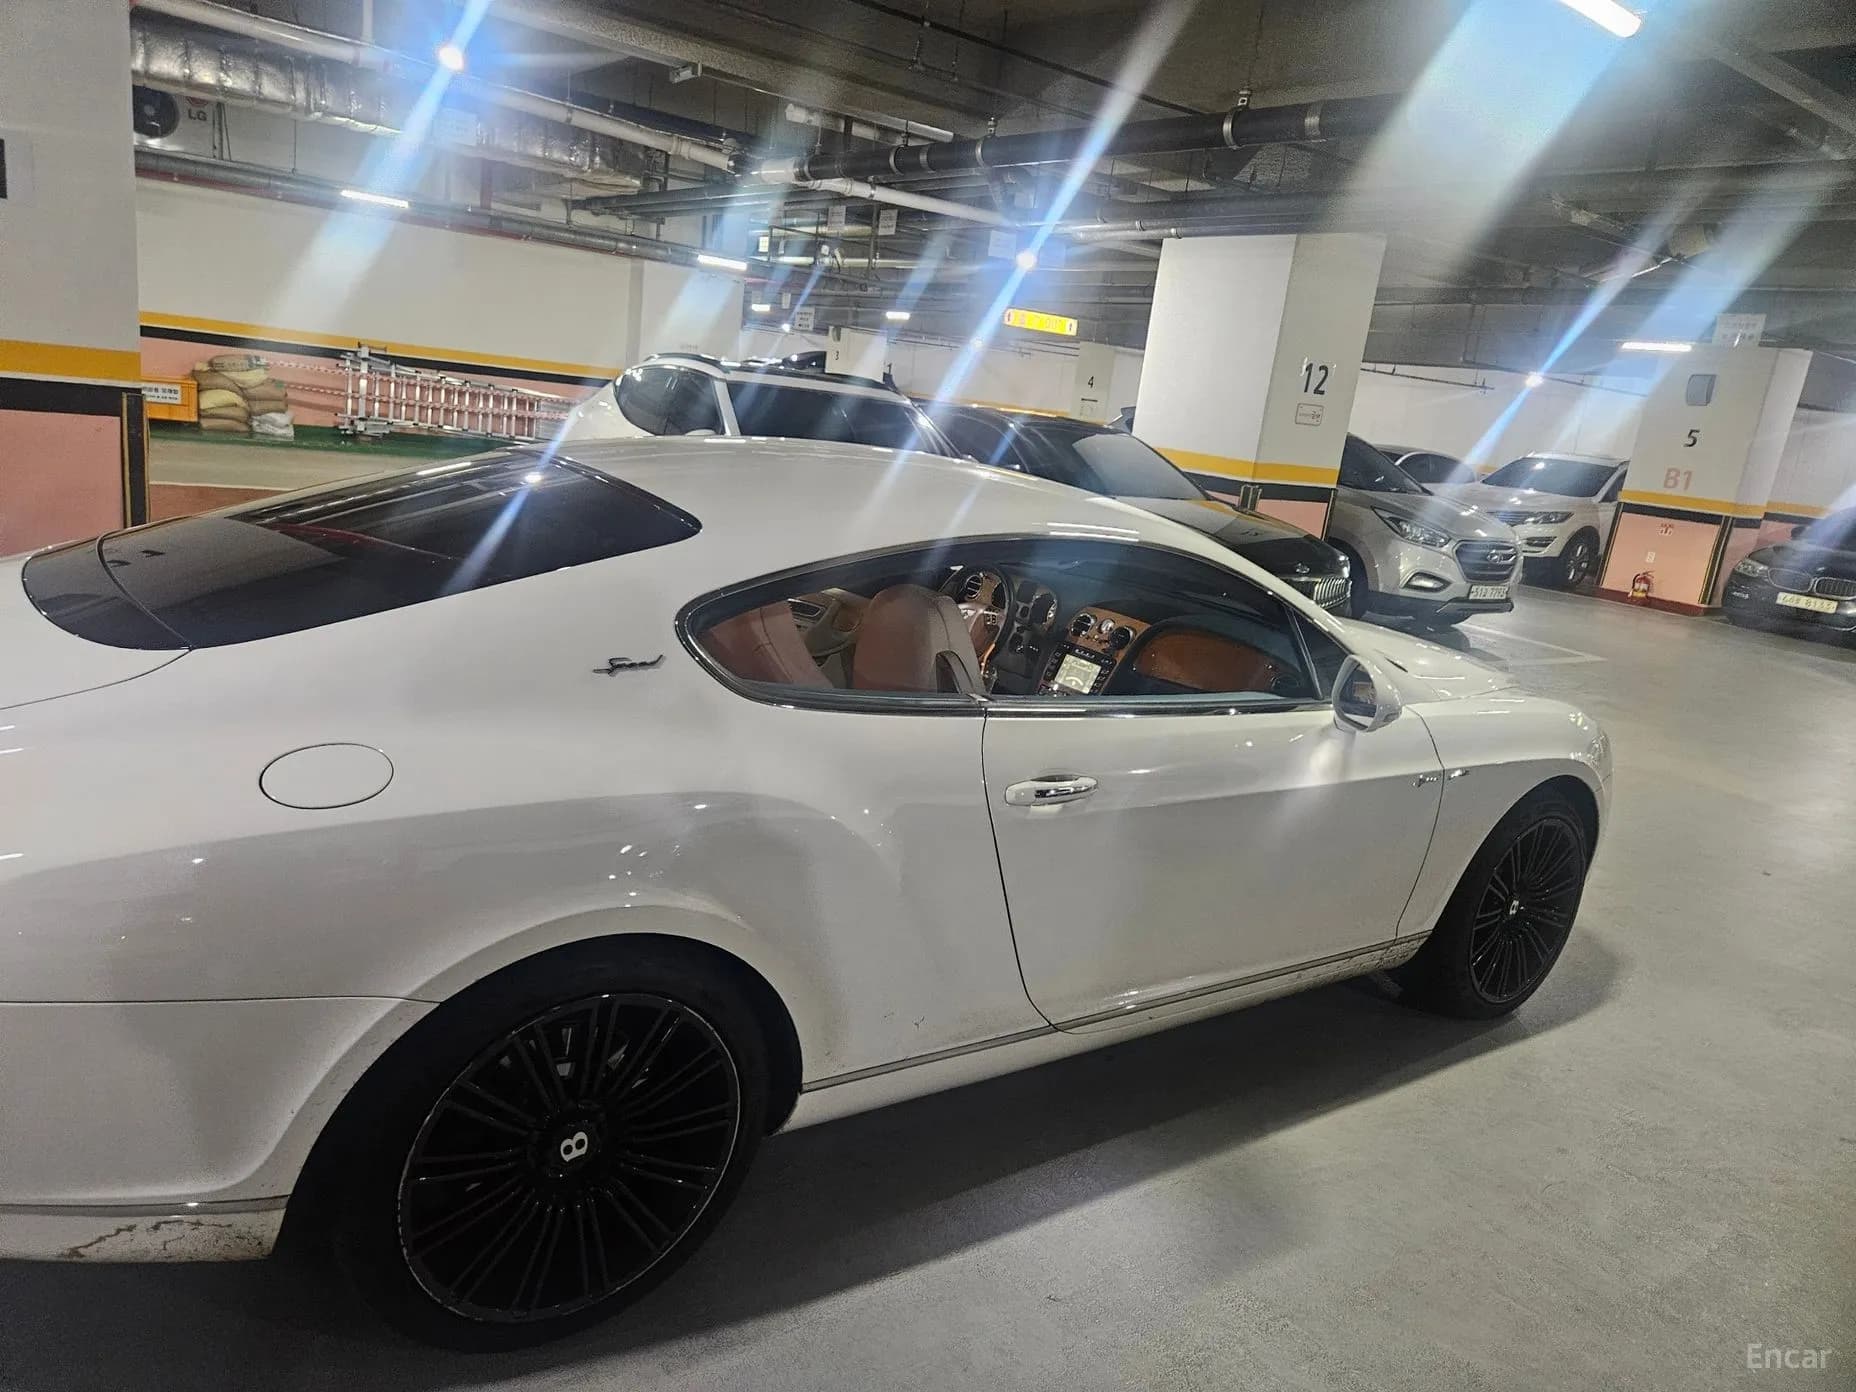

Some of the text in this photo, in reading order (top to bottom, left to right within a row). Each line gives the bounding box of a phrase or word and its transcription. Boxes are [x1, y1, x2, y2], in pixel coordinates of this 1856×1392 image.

[188, 108, 207, 121] LG
[834, 351, 840, 361] 3
[1087, 376, 1095, 388] 4
[1304, 363, 1328, 395] 12
[1683, 429, 1700, 447] 5
[1664, 467, 1693, 490] B1
[560, 1131, 588, 1162] B
